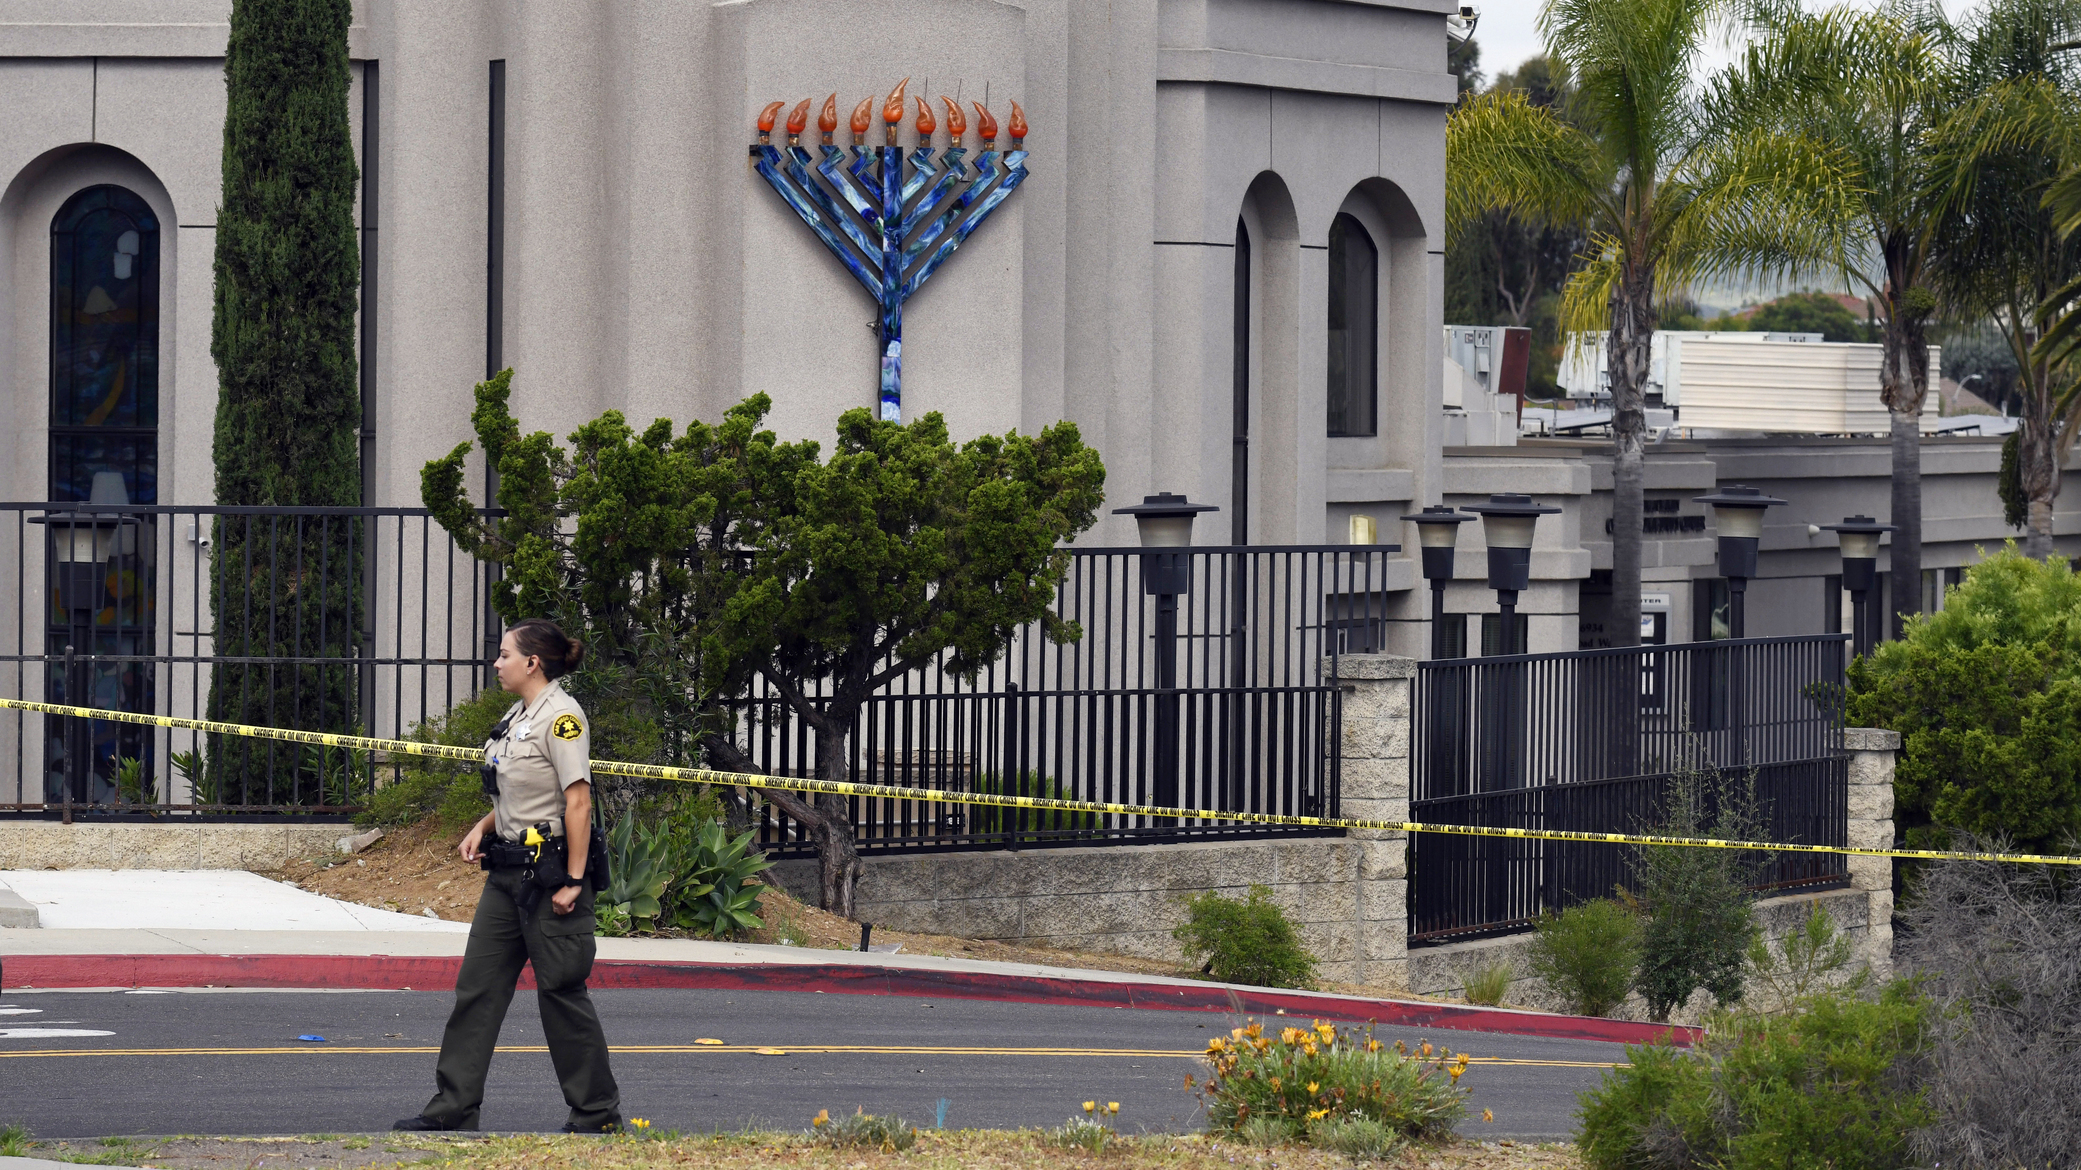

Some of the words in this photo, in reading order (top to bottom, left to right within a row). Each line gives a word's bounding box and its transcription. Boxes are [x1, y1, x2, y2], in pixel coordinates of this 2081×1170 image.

[1580, 623, 1604, 633] 6934
[557, 716, 569, 725] DIEGO
[337, 736, 358, 747] SHERIFF
[358, 738, 370, 748] LINE
[370, 739, 378, 749] DO
[379, 740, 390, 750] NOT
[390, 742, 407, 752] CROSS
[421, 745, 442, 756] SHERIFF
[442, 747, 454, 757] LINE
[454, 748, 462, 758] DO
[464, 749, 474, 760] NOT
[474, 750, 484, 761] CRO
[591, 761, 612, 773] SHERIFF
[613, 763, 625, 774] LINE
[626, 764, 634, 775] DO
[634, 765, 645, 776] NOT
[646, 766, 664, 778] CROSS
[678, 769, 700, 781] SHERIFF
[700, 771, 712, 782] LINE
[713, 772, 721, 783] DO
[722, 773, 732, 784] NOT
[733, 774, 750, 786] CROSS
[765, 777, 787, 788] SHERIFF
[788, 779, 800, 790] LINE
[800, 780, 808, 790] DO
[809, 780, 820, 791] NOT
[820, 781, 838, 793] CROSS
[853, 784, 876, 796] SHERIFF
[876, 786, 888, 797] LINE
[889, 787, 897, 797] DO
[898, 788, 909, 798] NOT
[910, 788, 927, 800] CROSS
[942, 791, 964, 802] SHERIFF
[964, 793, 977, 802] LINE
[978, 794, 986, 803] DO
[987, 794, 998, 804] NOT
[999, 795, 1017, 805] CROSS
[1032, 798, 1054, 808] SHERIFF
[1055, 799, 1068, 809] LINE
[1068, 800, 1077, 809] DO
[1078, 801, 1088, 810] NOT
[1090, 802, 1108, 812] CROSS
